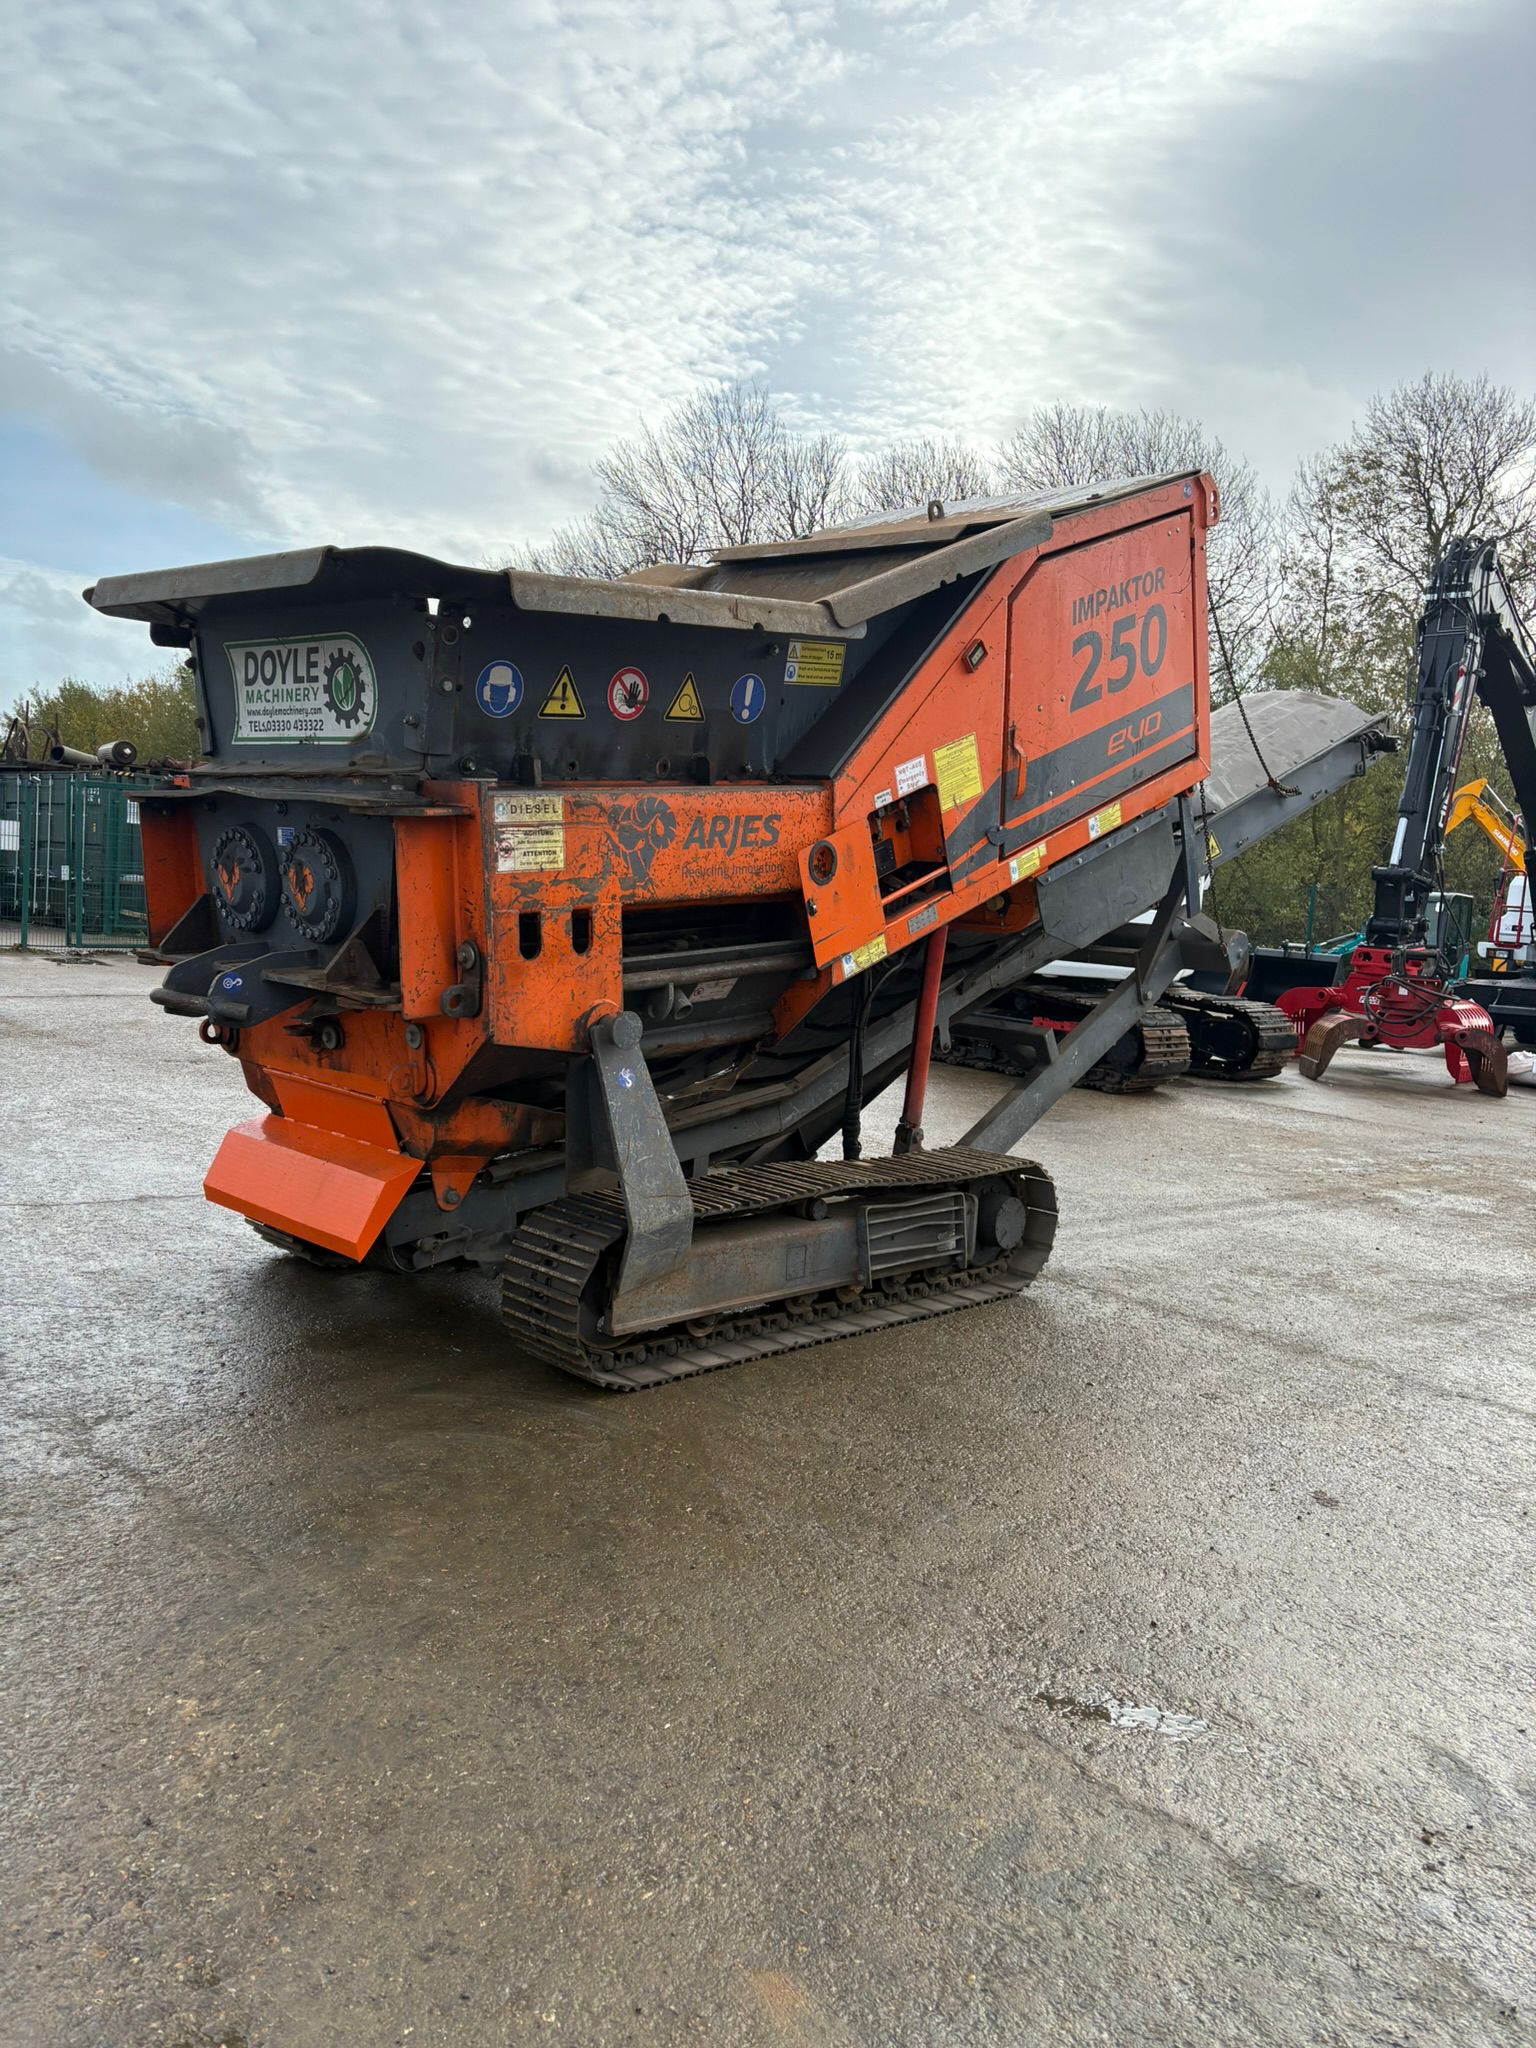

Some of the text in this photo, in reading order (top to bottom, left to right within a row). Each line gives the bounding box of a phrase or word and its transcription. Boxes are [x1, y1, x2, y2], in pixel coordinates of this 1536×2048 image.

[1072, 566, 1166, 626] IMPAKTOR
[826, 650, 835, 660] 15
[1069, 603, 1168, 713] 250
[244, 646, 320, 687] DOYLE
[245, 687, 320, 703] MACHINERY
[246, 705, 323, 718] www.doylemachinery.com
[293, 719, 324, 731] 433322
[510, 804, 559, 814] DIESEL
[681, 814, 781, 857] ARJES
